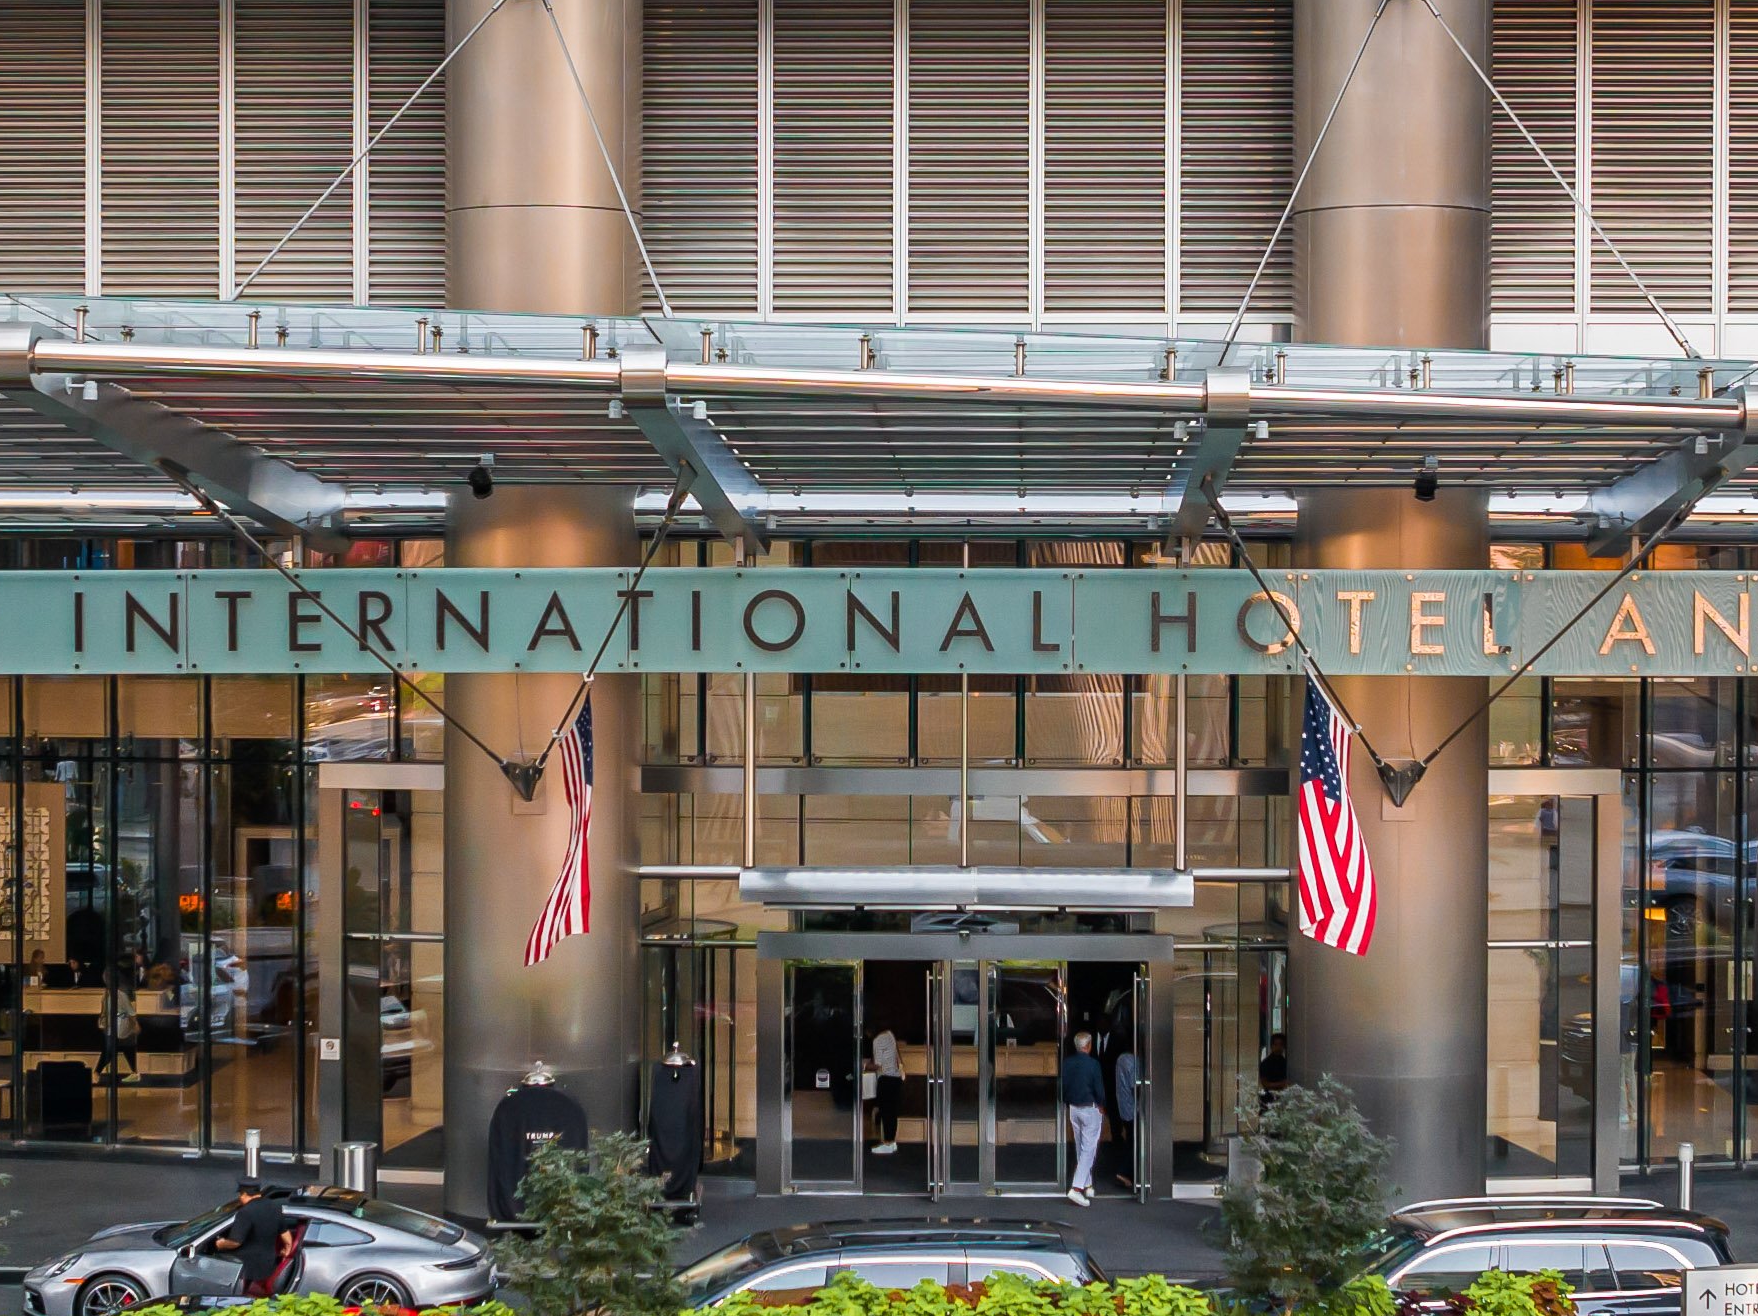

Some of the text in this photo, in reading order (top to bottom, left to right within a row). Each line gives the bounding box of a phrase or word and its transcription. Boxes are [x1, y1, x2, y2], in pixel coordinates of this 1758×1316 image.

[73, 589, 1061, 654] INTERNATIONAL
[1150, 589, 1512, 656] HOTEL
[526, 1132, 554, 1140] TRUMP
